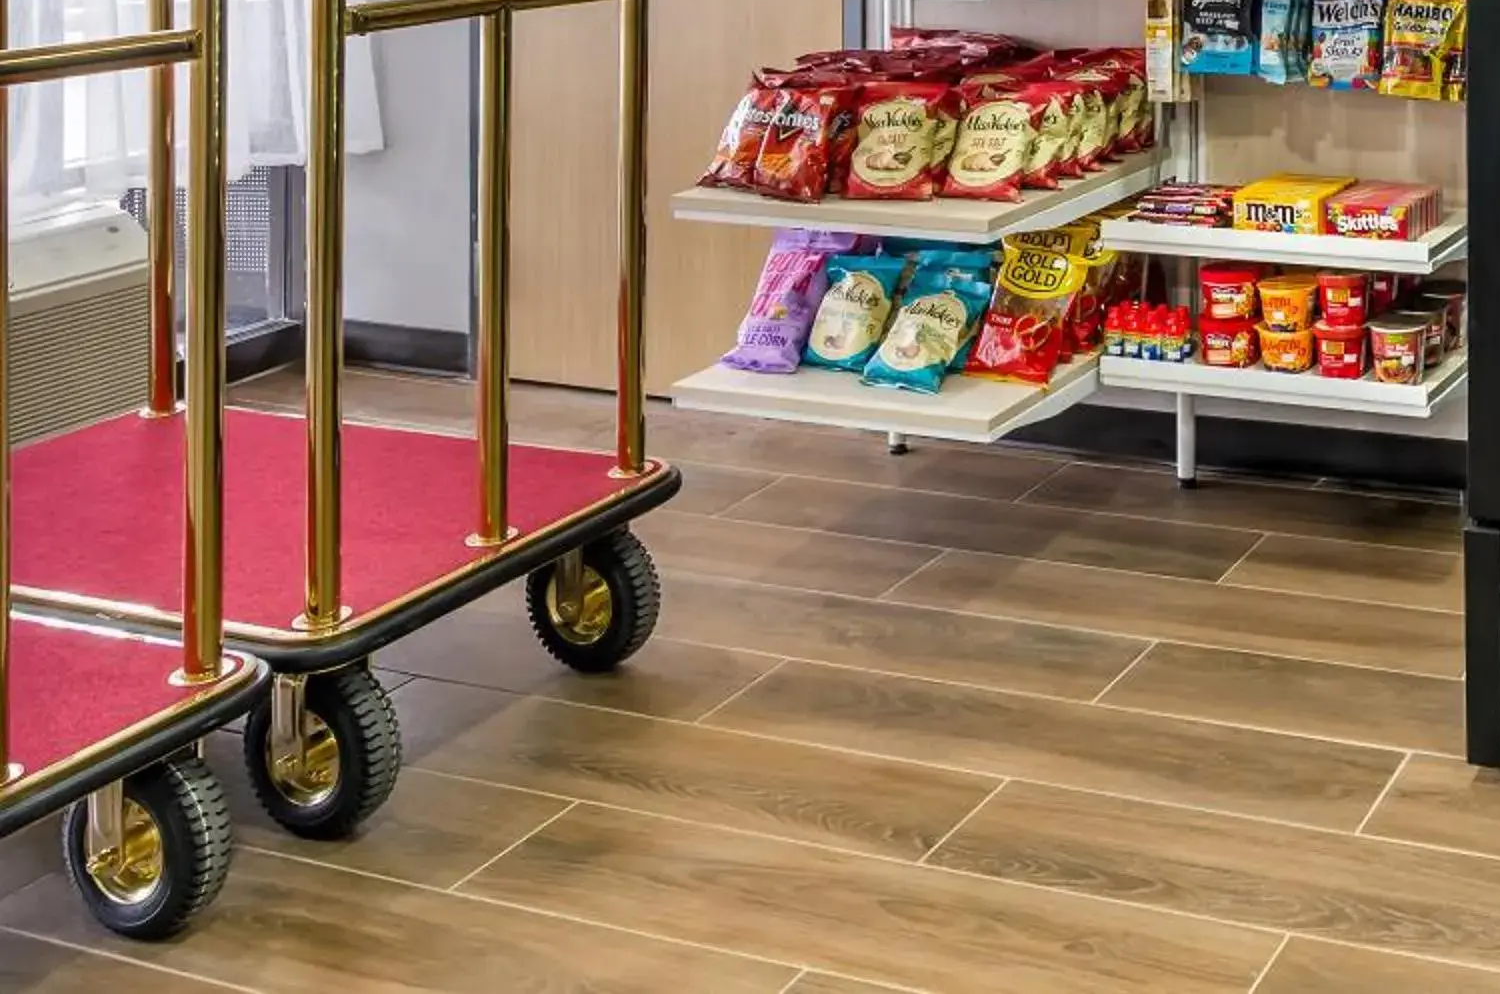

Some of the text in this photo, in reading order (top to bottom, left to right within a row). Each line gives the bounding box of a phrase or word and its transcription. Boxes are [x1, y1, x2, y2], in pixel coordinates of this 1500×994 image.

[1317, 1, 1380, 23] Welch's
[1393, 3, 1453, 21] HARIBO
[1337, 213, 1399, 233] Skittles
[1011, 265, 1058, 288] GOLD
